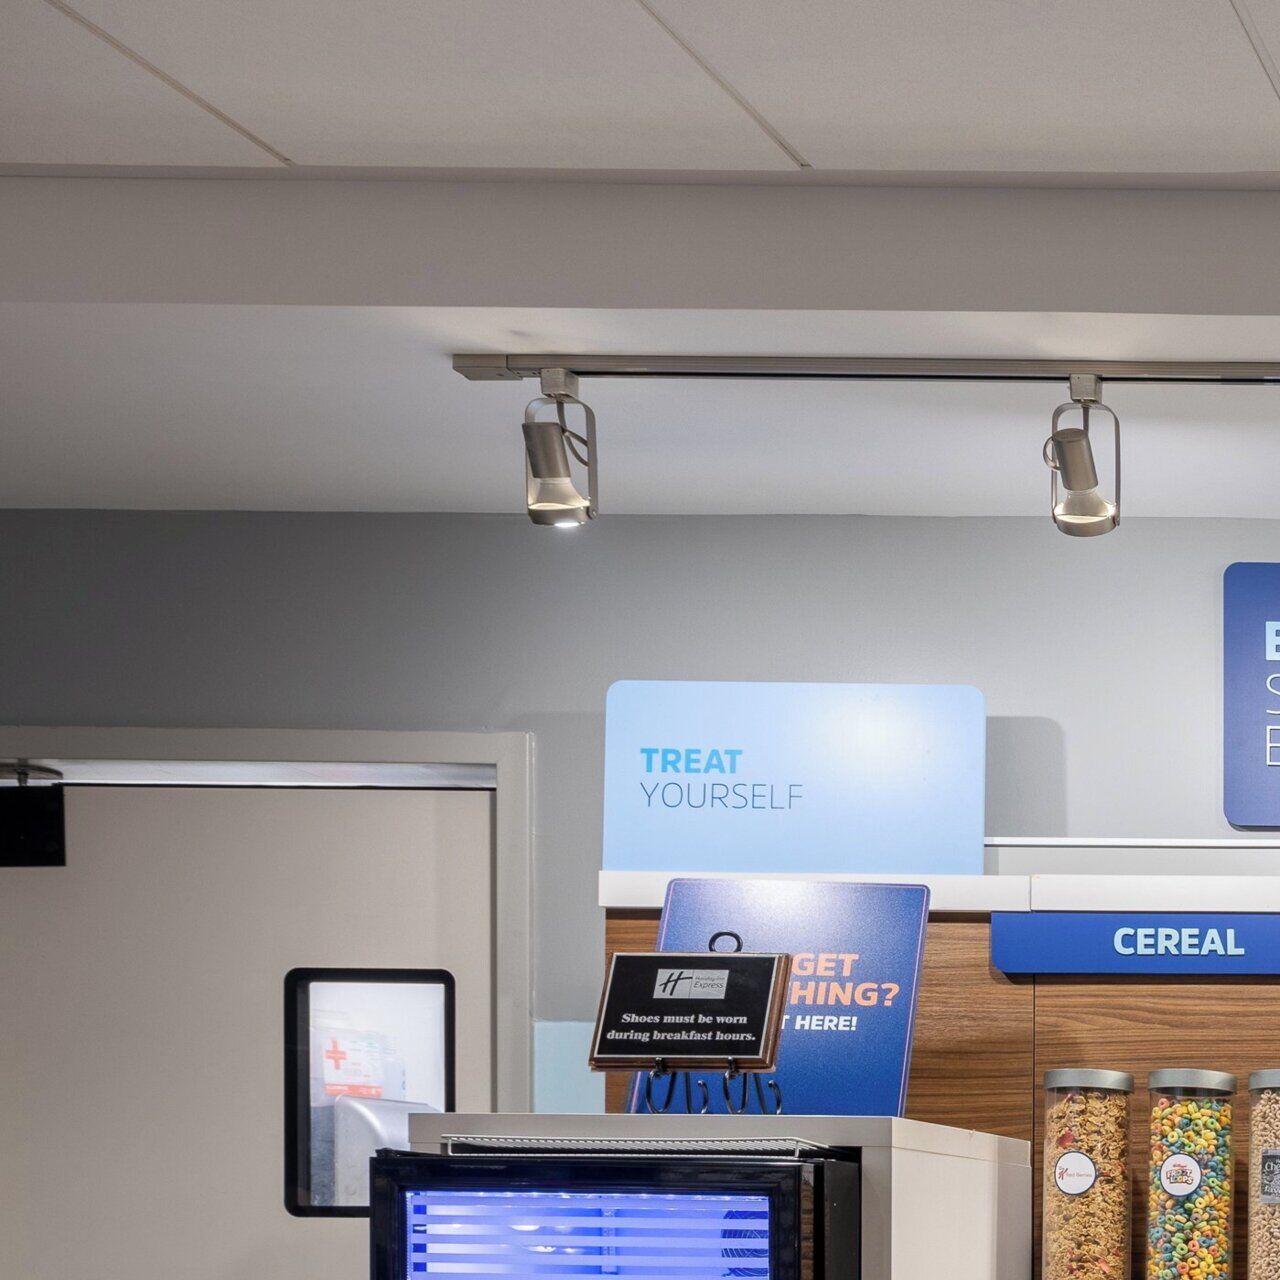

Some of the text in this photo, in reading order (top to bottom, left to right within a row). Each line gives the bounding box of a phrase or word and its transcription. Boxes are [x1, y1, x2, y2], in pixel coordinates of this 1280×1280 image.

[640, 748, 743, 774] TREAT
[640, 782, 803, 810] YOURSELF
[1113, 927, 1246, 956] CEREAL
[791, 952, 860, 977] GET
[693, 981, 724, 989] Express
[788, 981, 900, 1007] HING?
[621, 1013, 748, 1025] Shoes must be worn
[795, 1015, 858, 1031] HERE!
[606, 1030, 756, 1042] during breakfast hours.
